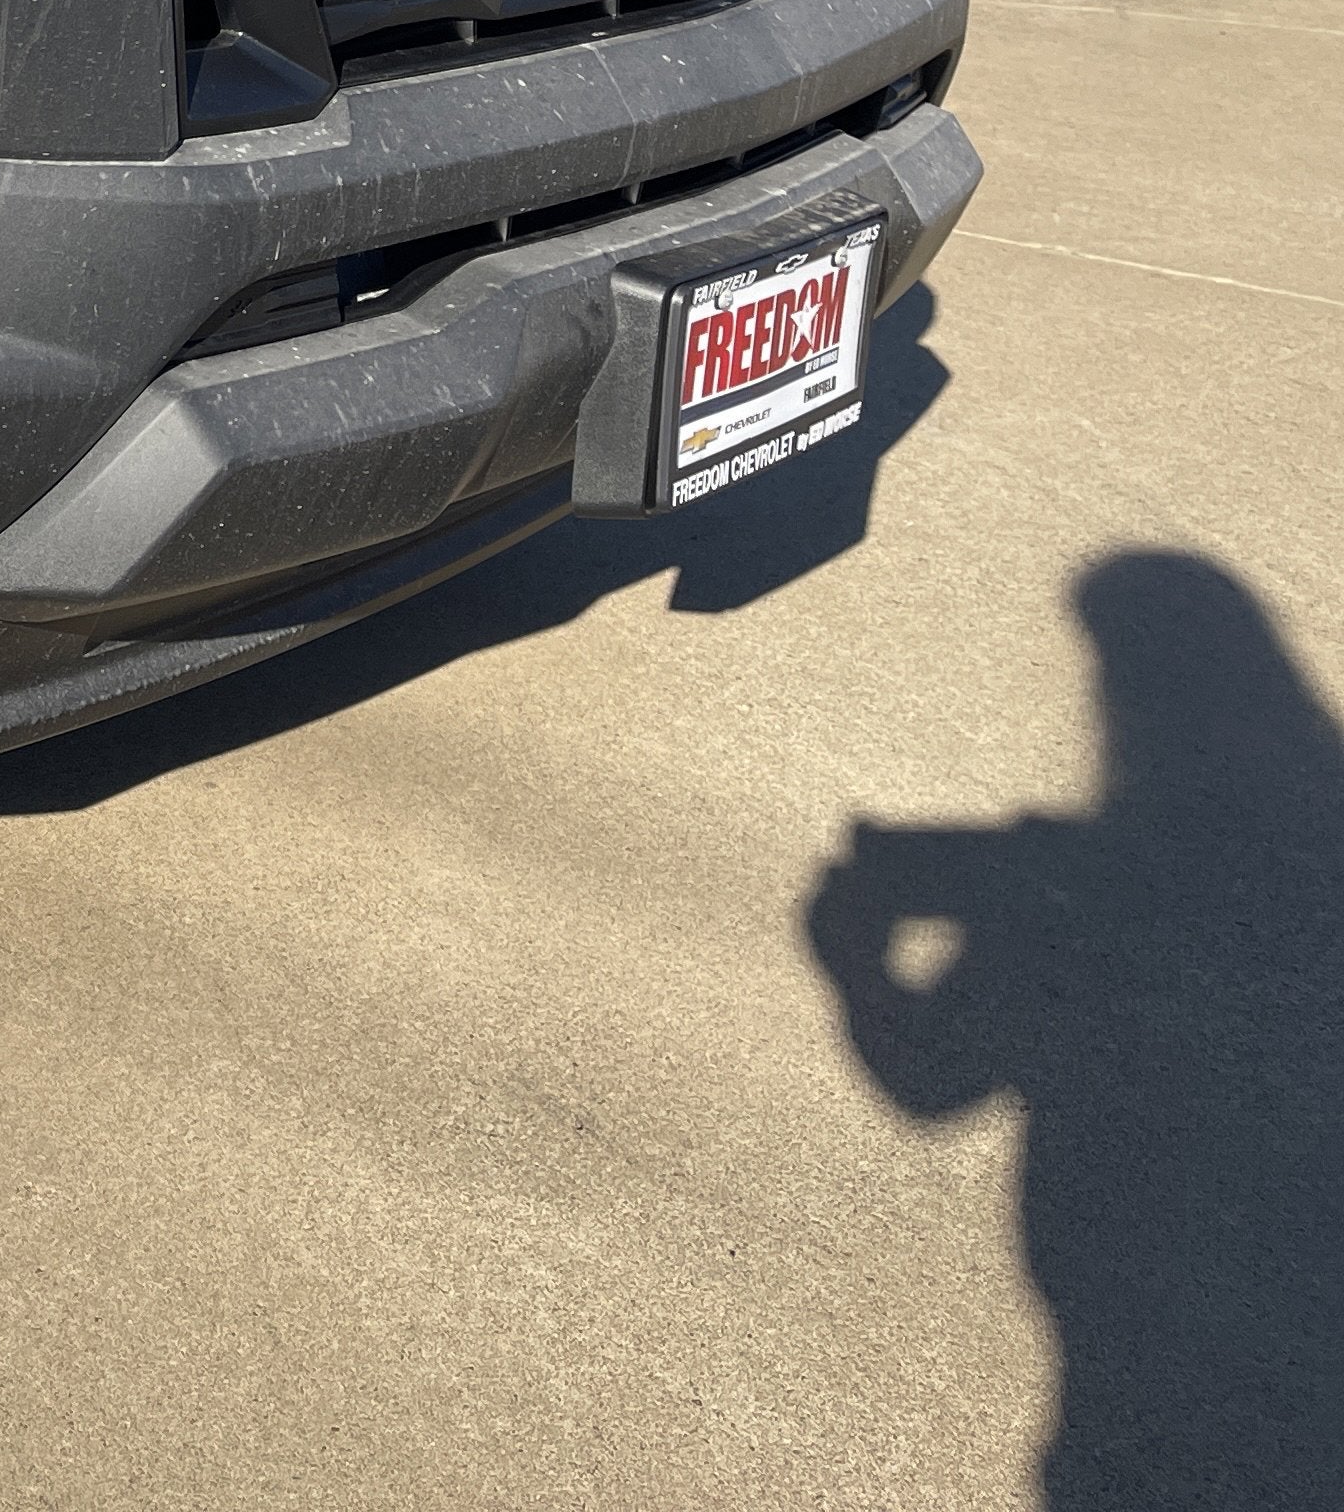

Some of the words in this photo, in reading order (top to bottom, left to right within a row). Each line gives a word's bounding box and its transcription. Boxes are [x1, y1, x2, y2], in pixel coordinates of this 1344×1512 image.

[692, 269, 758, 305] FAIRFIELD
[845, 223, 881, 248] TEXAS
[681, 265, 850, 407] FREEDOM
[724, 407, 772, 434] CHEVROLET
[672, 461, 730, 507] FREEDOM
[731, 430, 796, 481] CHEVROLET
